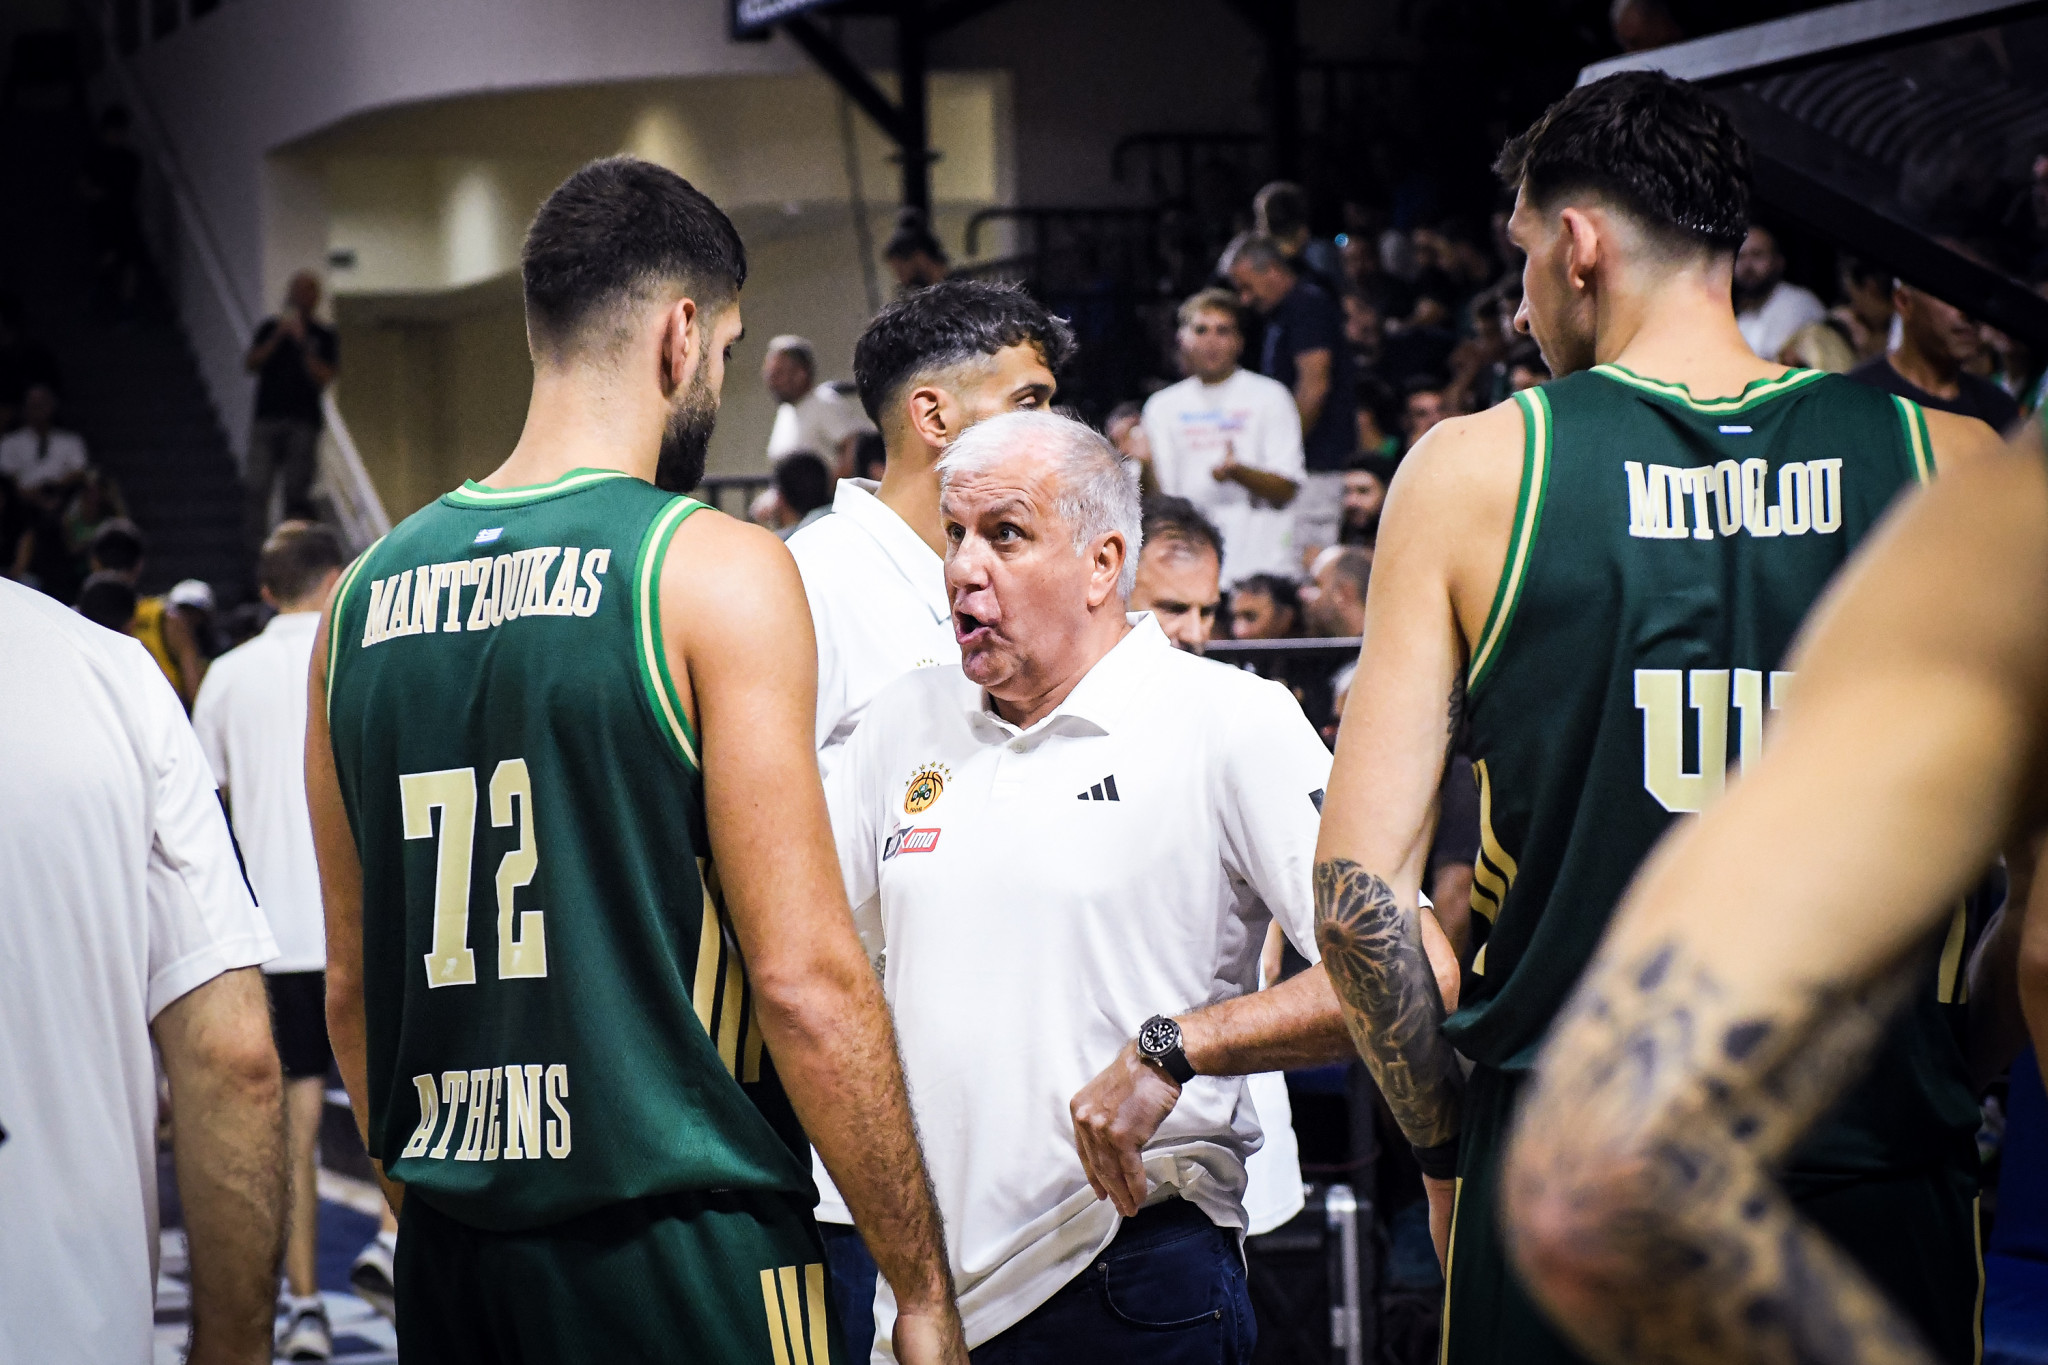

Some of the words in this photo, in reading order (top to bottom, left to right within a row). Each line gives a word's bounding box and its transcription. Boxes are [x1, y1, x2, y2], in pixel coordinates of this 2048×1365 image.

[361, 546, 612, 648] MANTZOUKAS
[399, 758, 547, 988] 72
[400, 1064, 572, 1161] ATHENS
